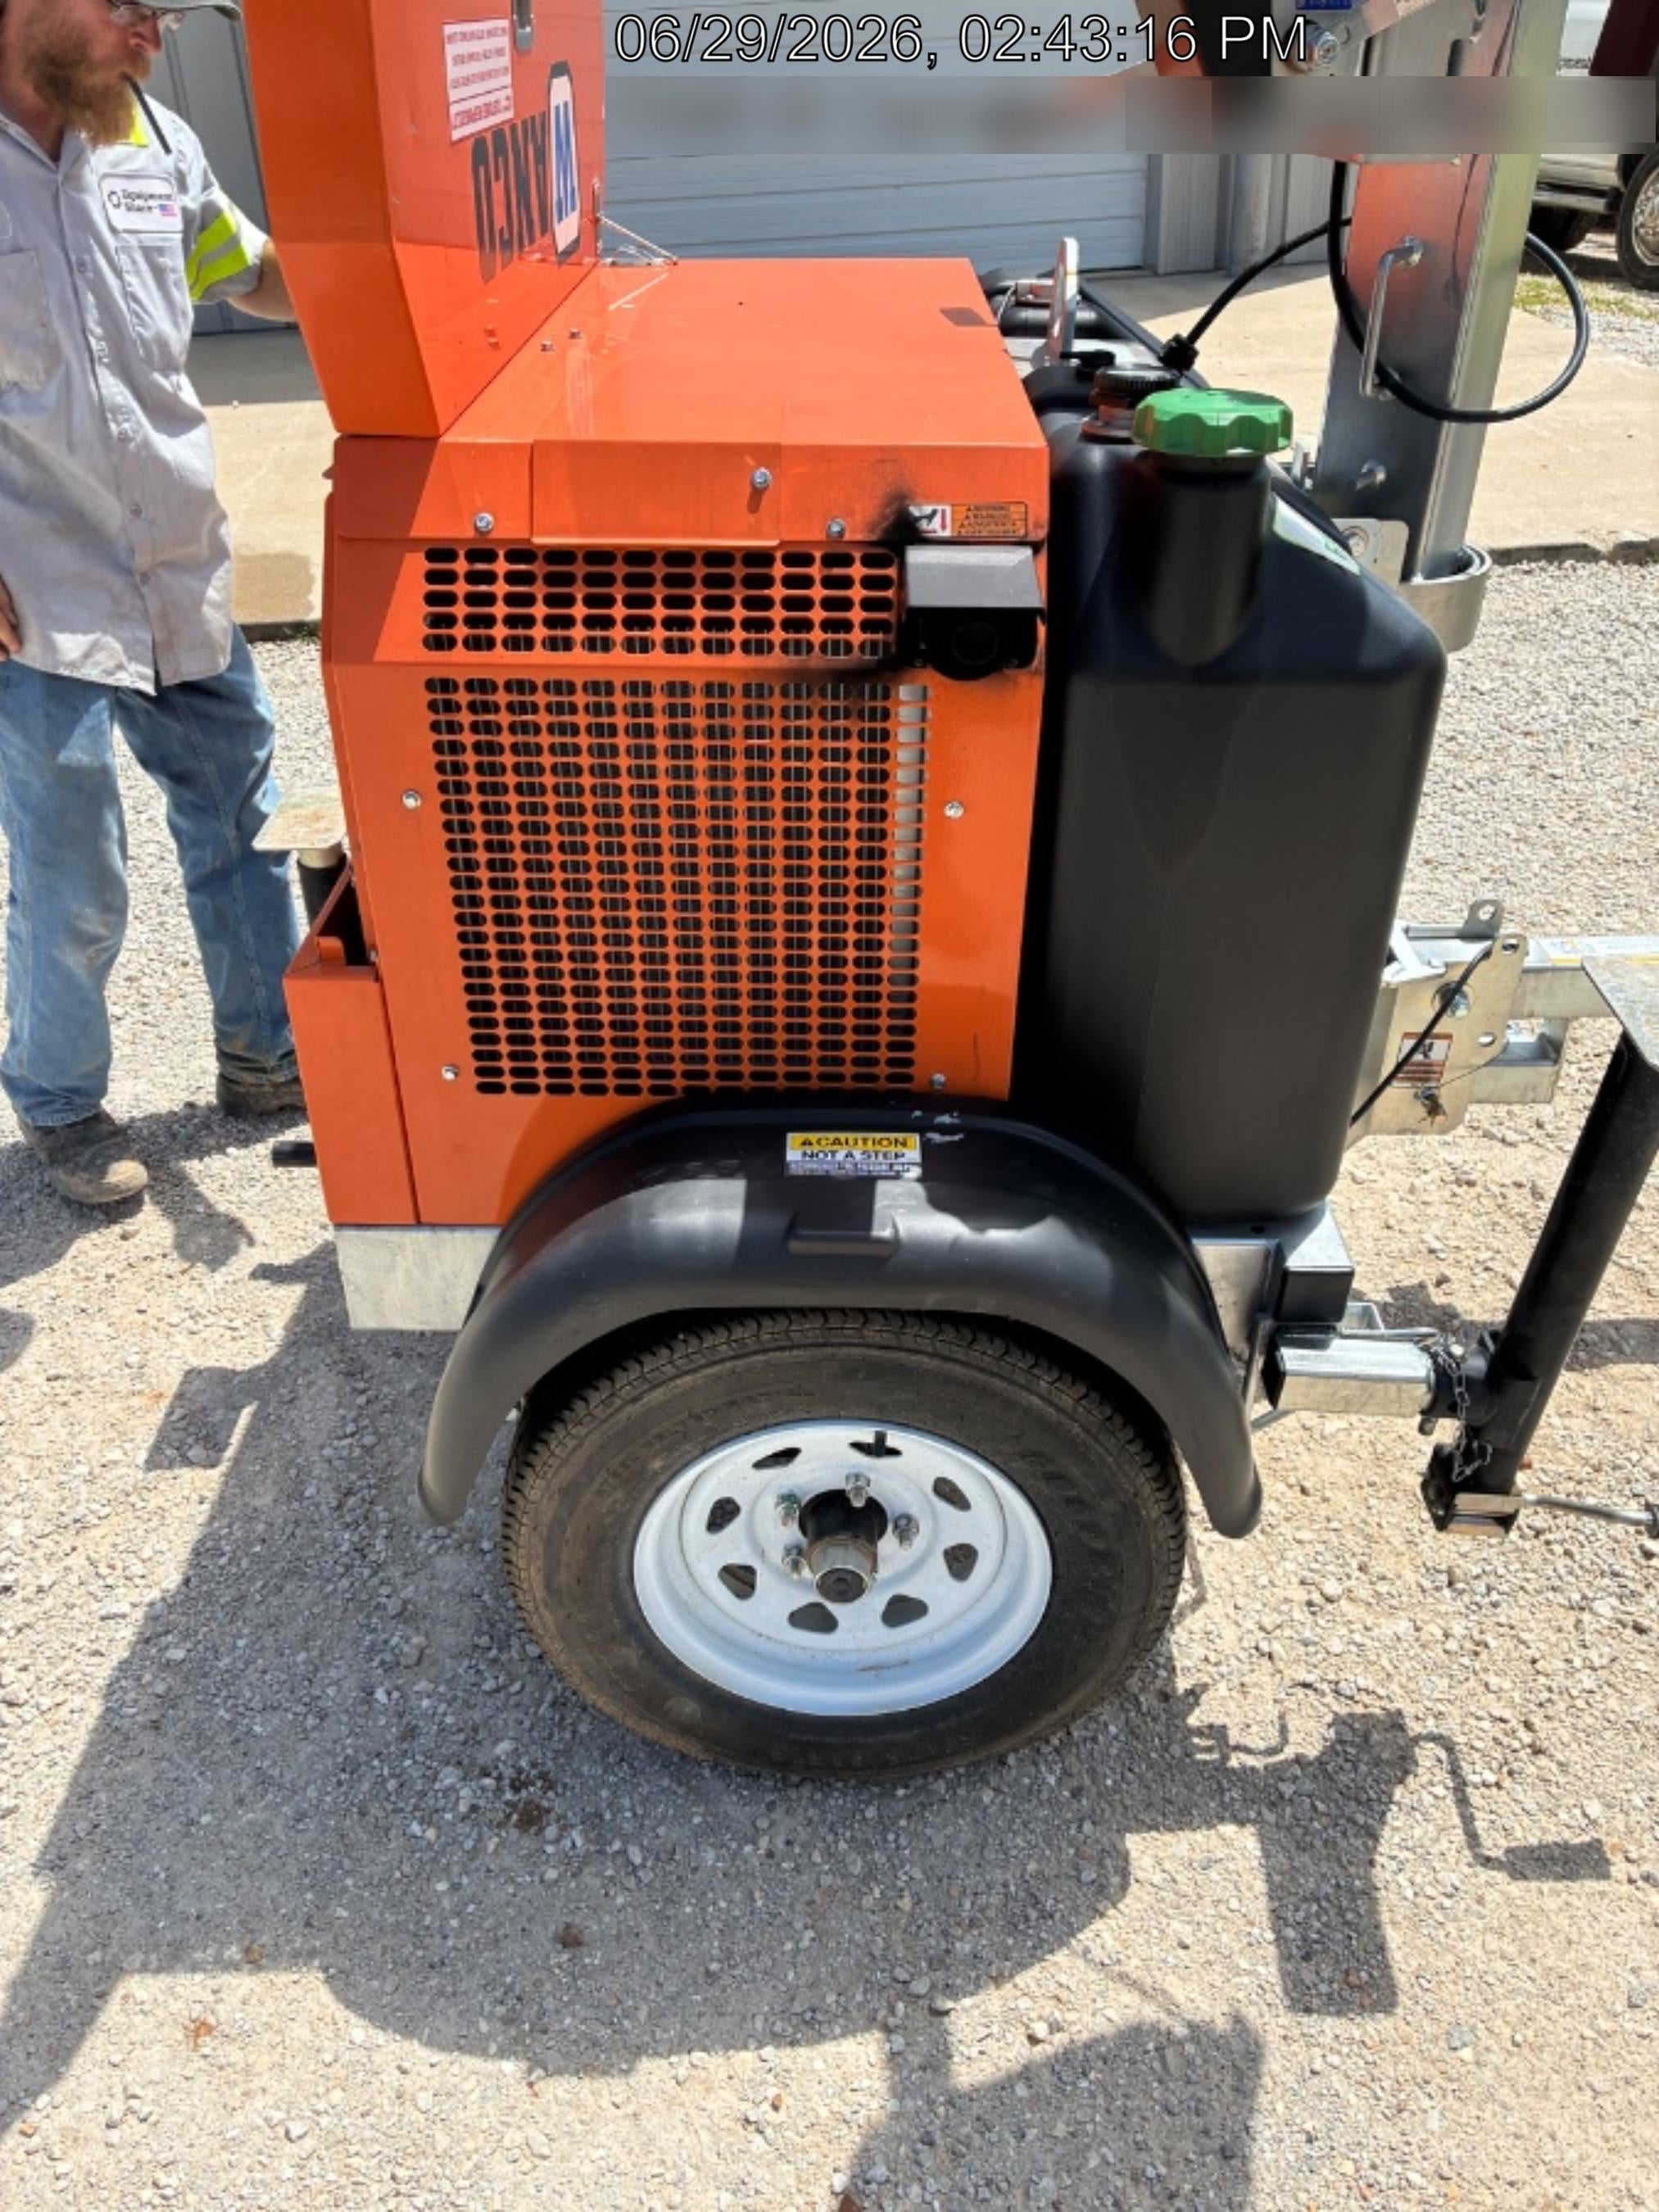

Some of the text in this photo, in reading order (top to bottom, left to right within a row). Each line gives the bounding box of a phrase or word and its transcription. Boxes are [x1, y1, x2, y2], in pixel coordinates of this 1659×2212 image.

[472, 97, 577, 283] WANCO
[817, 1136, 908, 1149] CAUTION
[801, 1149, 905, 1162] NOT A STEP
